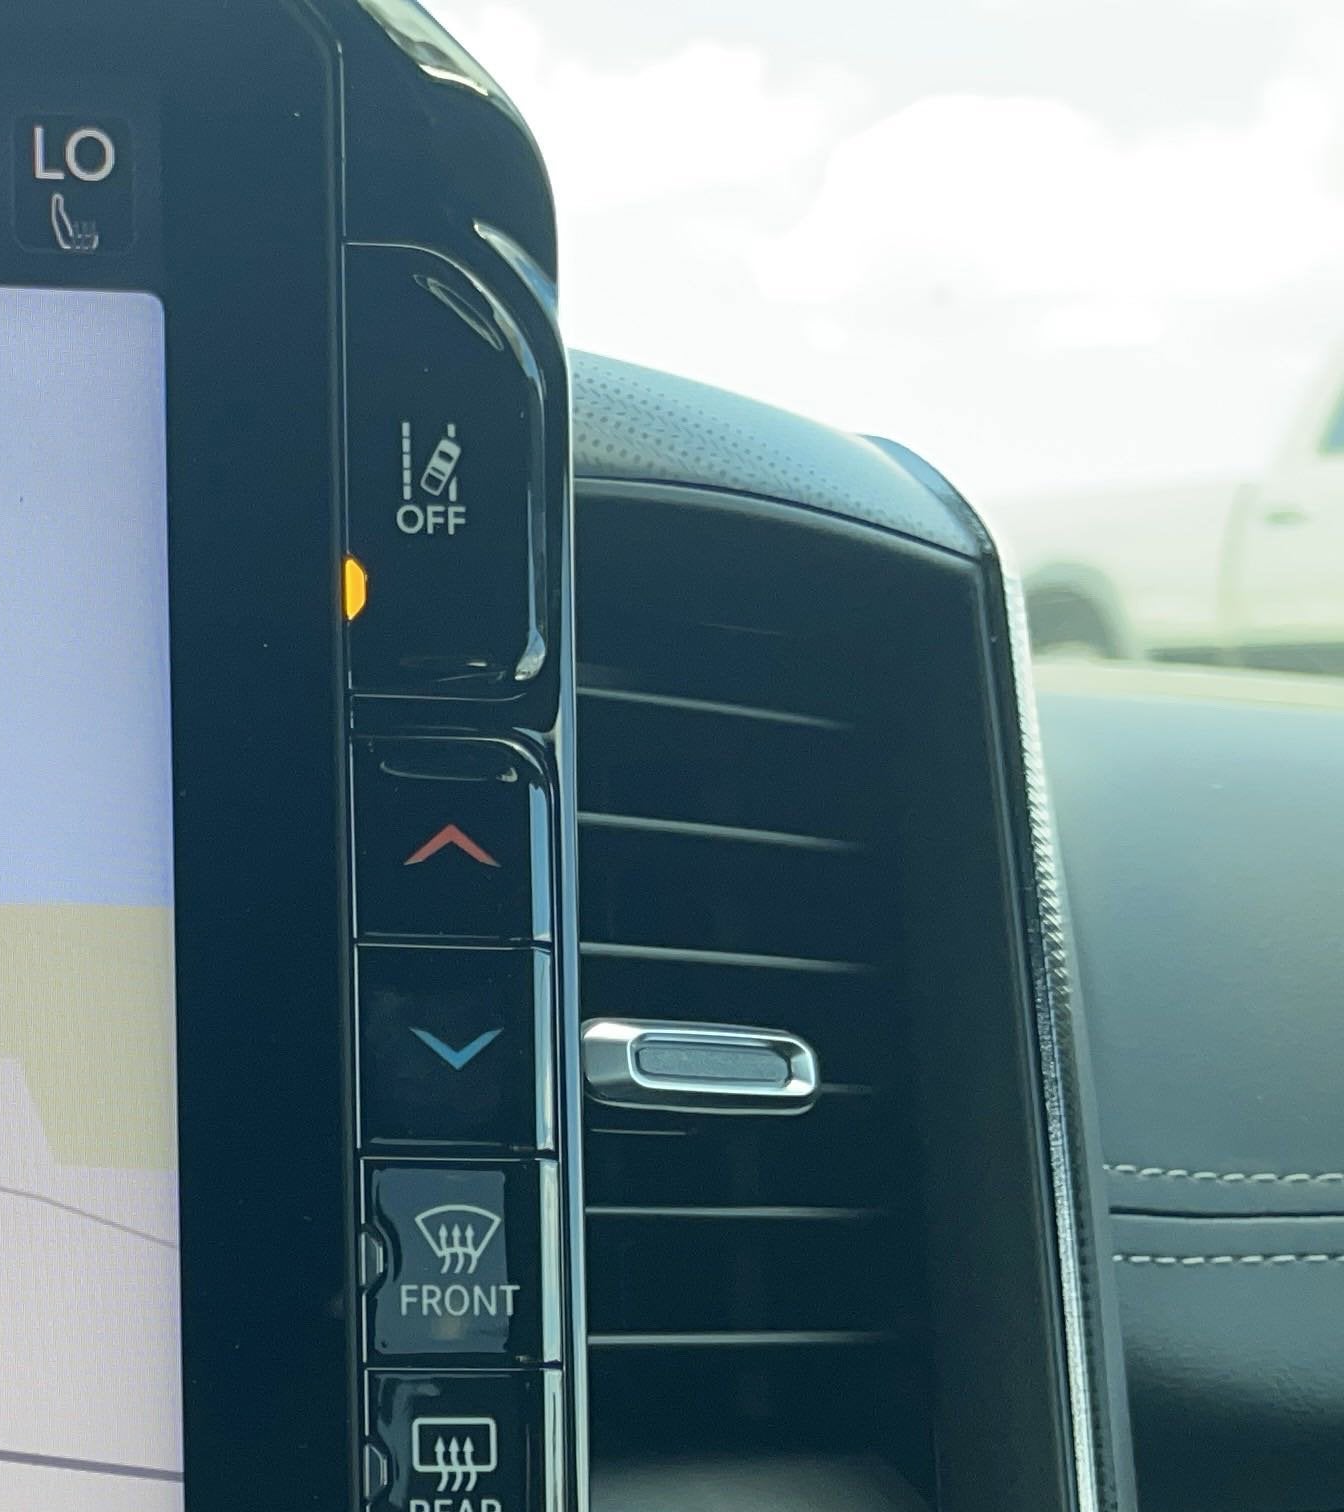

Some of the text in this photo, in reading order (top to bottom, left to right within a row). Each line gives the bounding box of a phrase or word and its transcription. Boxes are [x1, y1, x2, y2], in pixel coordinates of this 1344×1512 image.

[33, 126, 115, 181] LO
[396, 504, 466, 535] OFF
[400, 1284, 521, 1316] FRONT
